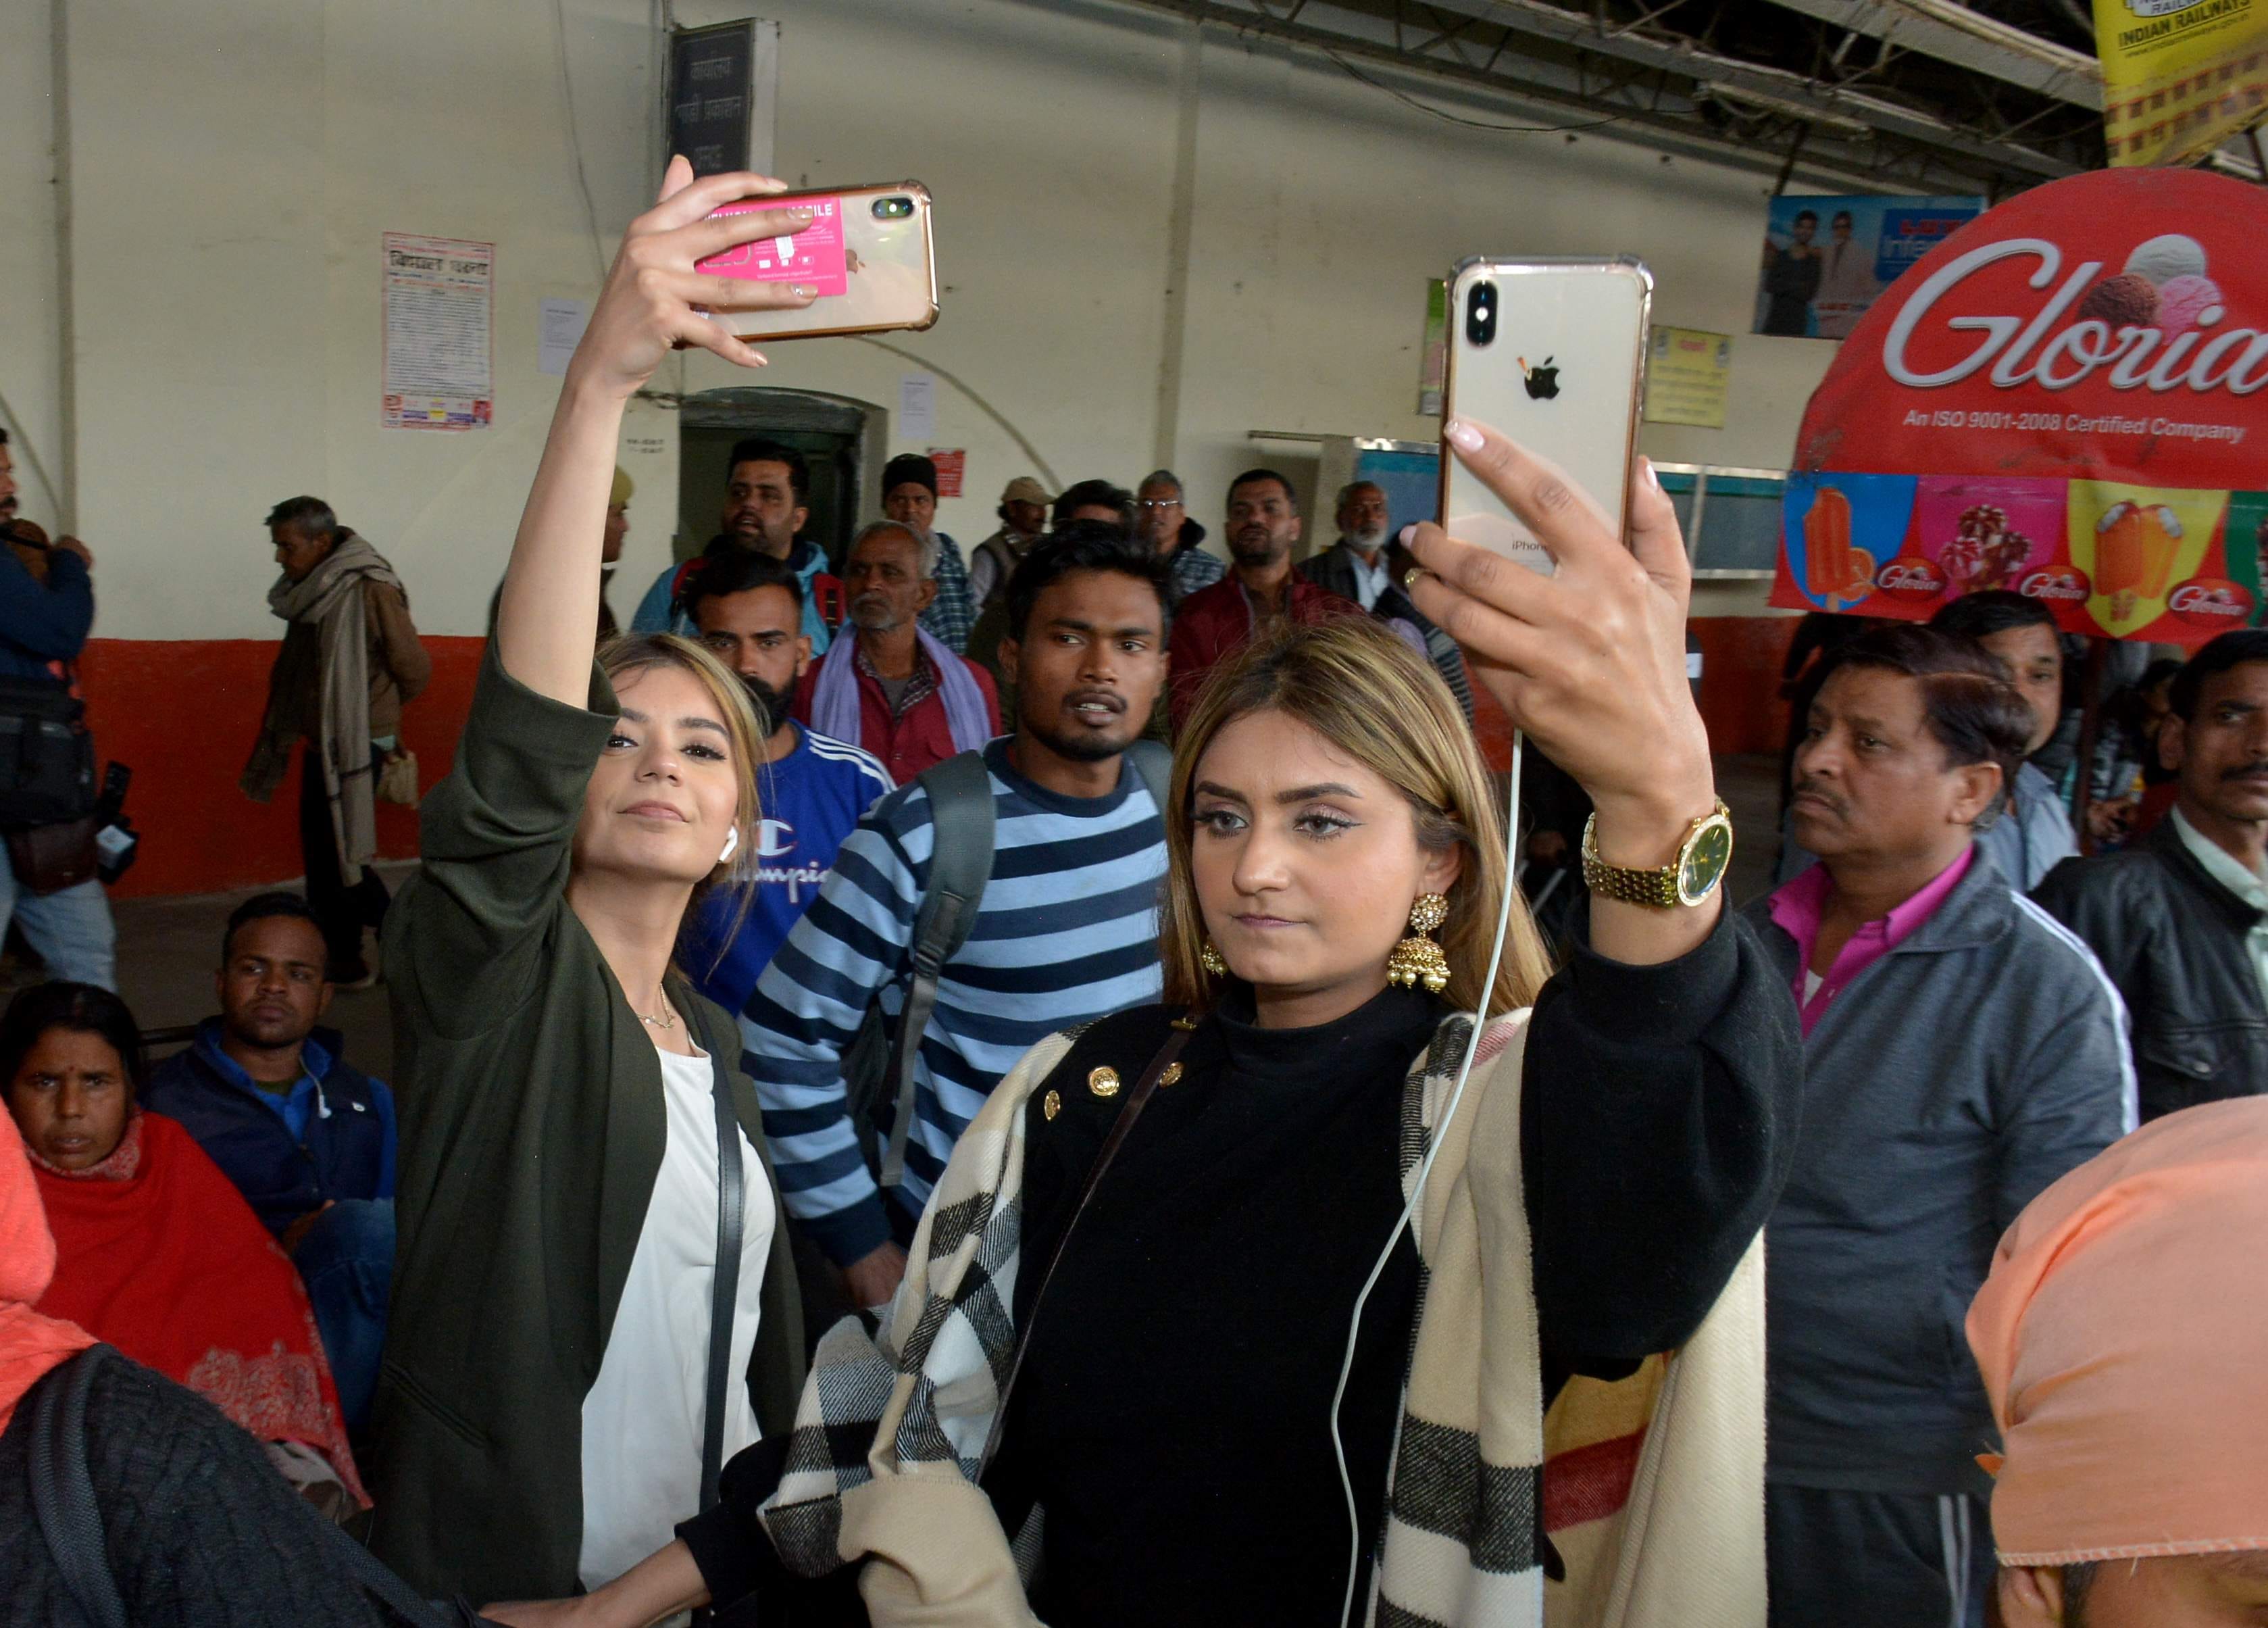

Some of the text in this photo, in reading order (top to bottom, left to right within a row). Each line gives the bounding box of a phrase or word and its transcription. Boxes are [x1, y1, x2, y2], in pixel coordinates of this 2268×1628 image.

[2119, 19, 2170, 47] INDIAN
[2175, 0, 2250, 28] RAILWAYS
[1883, 238, 2268, 394] Gloria
[1902, 410, 2247, 444] An ISO 9001-2008 Certified Company
[1512, 540, 1546, 551] iPhon
